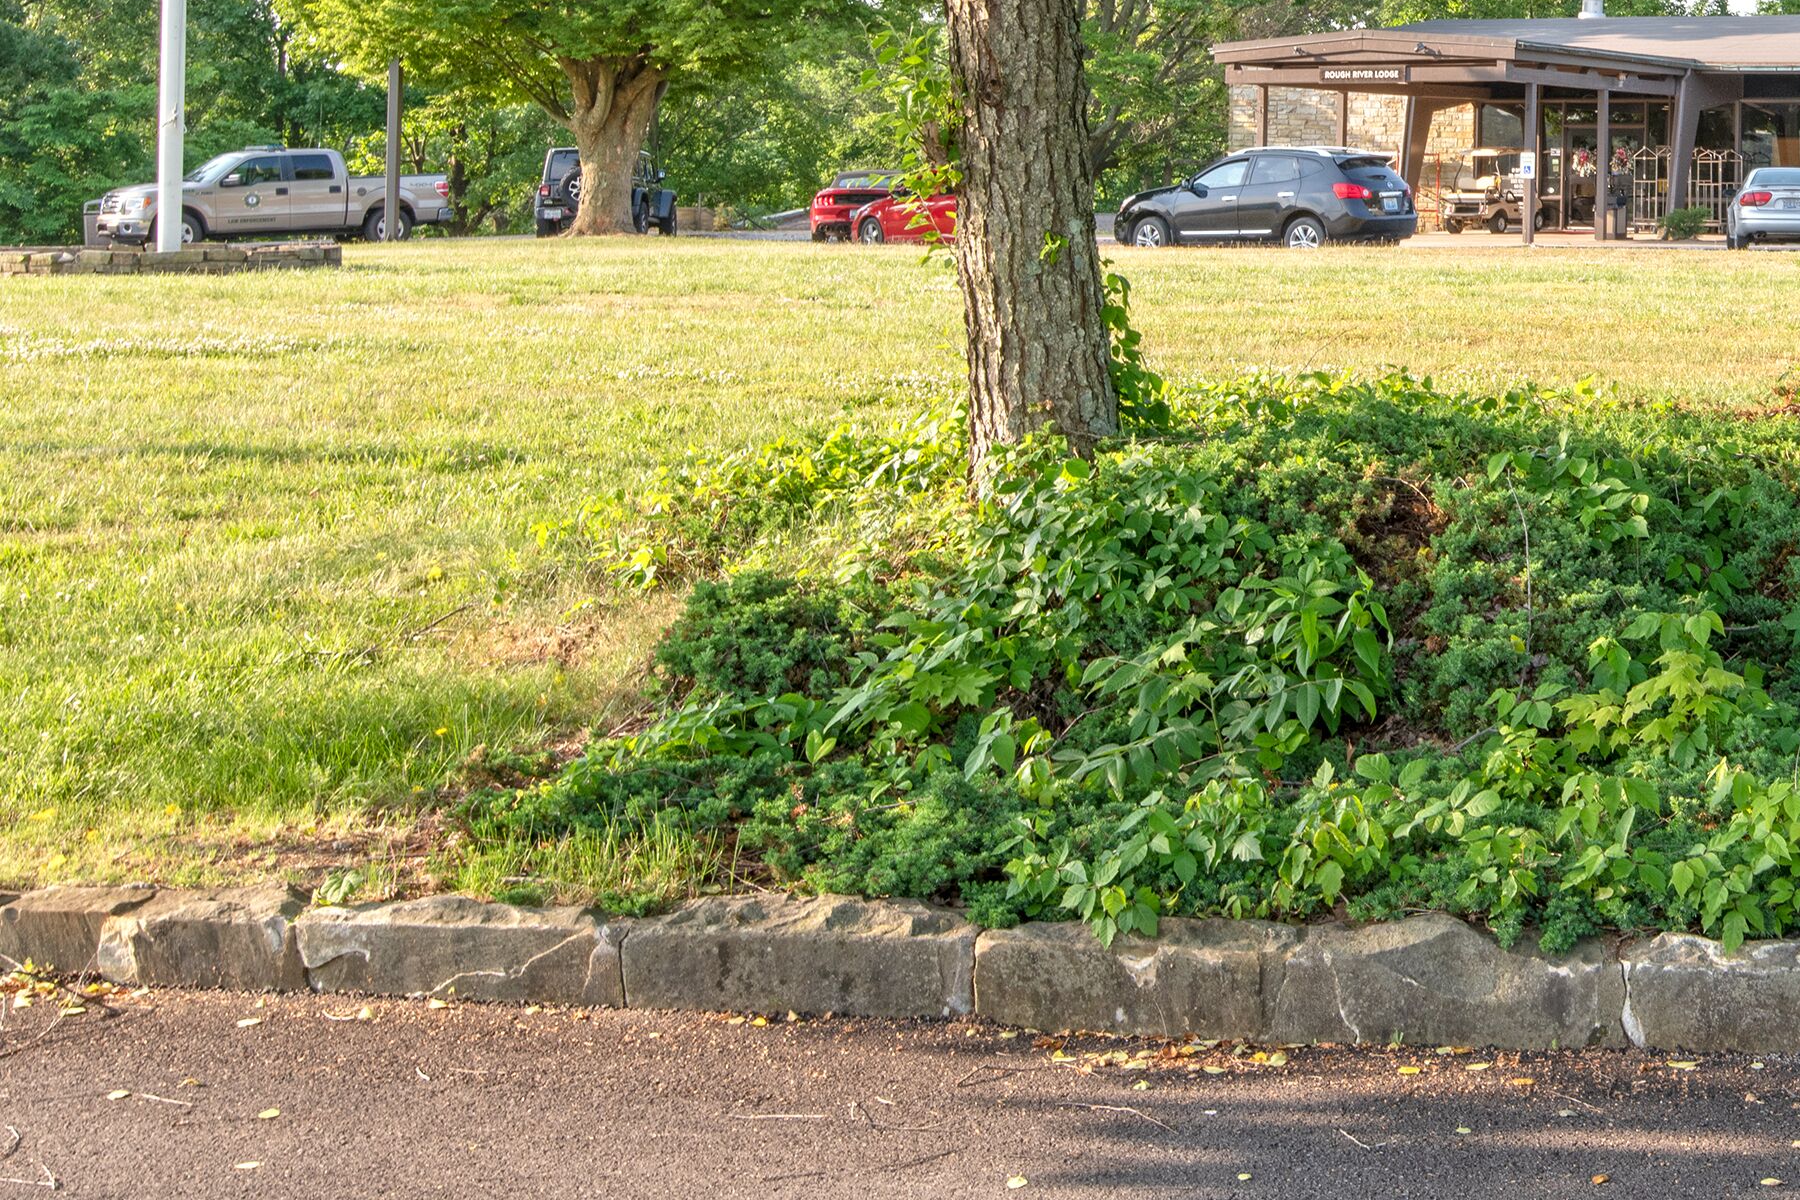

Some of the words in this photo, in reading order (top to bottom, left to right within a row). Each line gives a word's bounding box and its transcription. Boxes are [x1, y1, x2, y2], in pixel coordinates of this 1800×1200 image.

[1324, 70, 1351, 79] ROUGH
[1352, 70, 1373, 79] RIVER
[1374, 70, 1399, 78] LODGE
